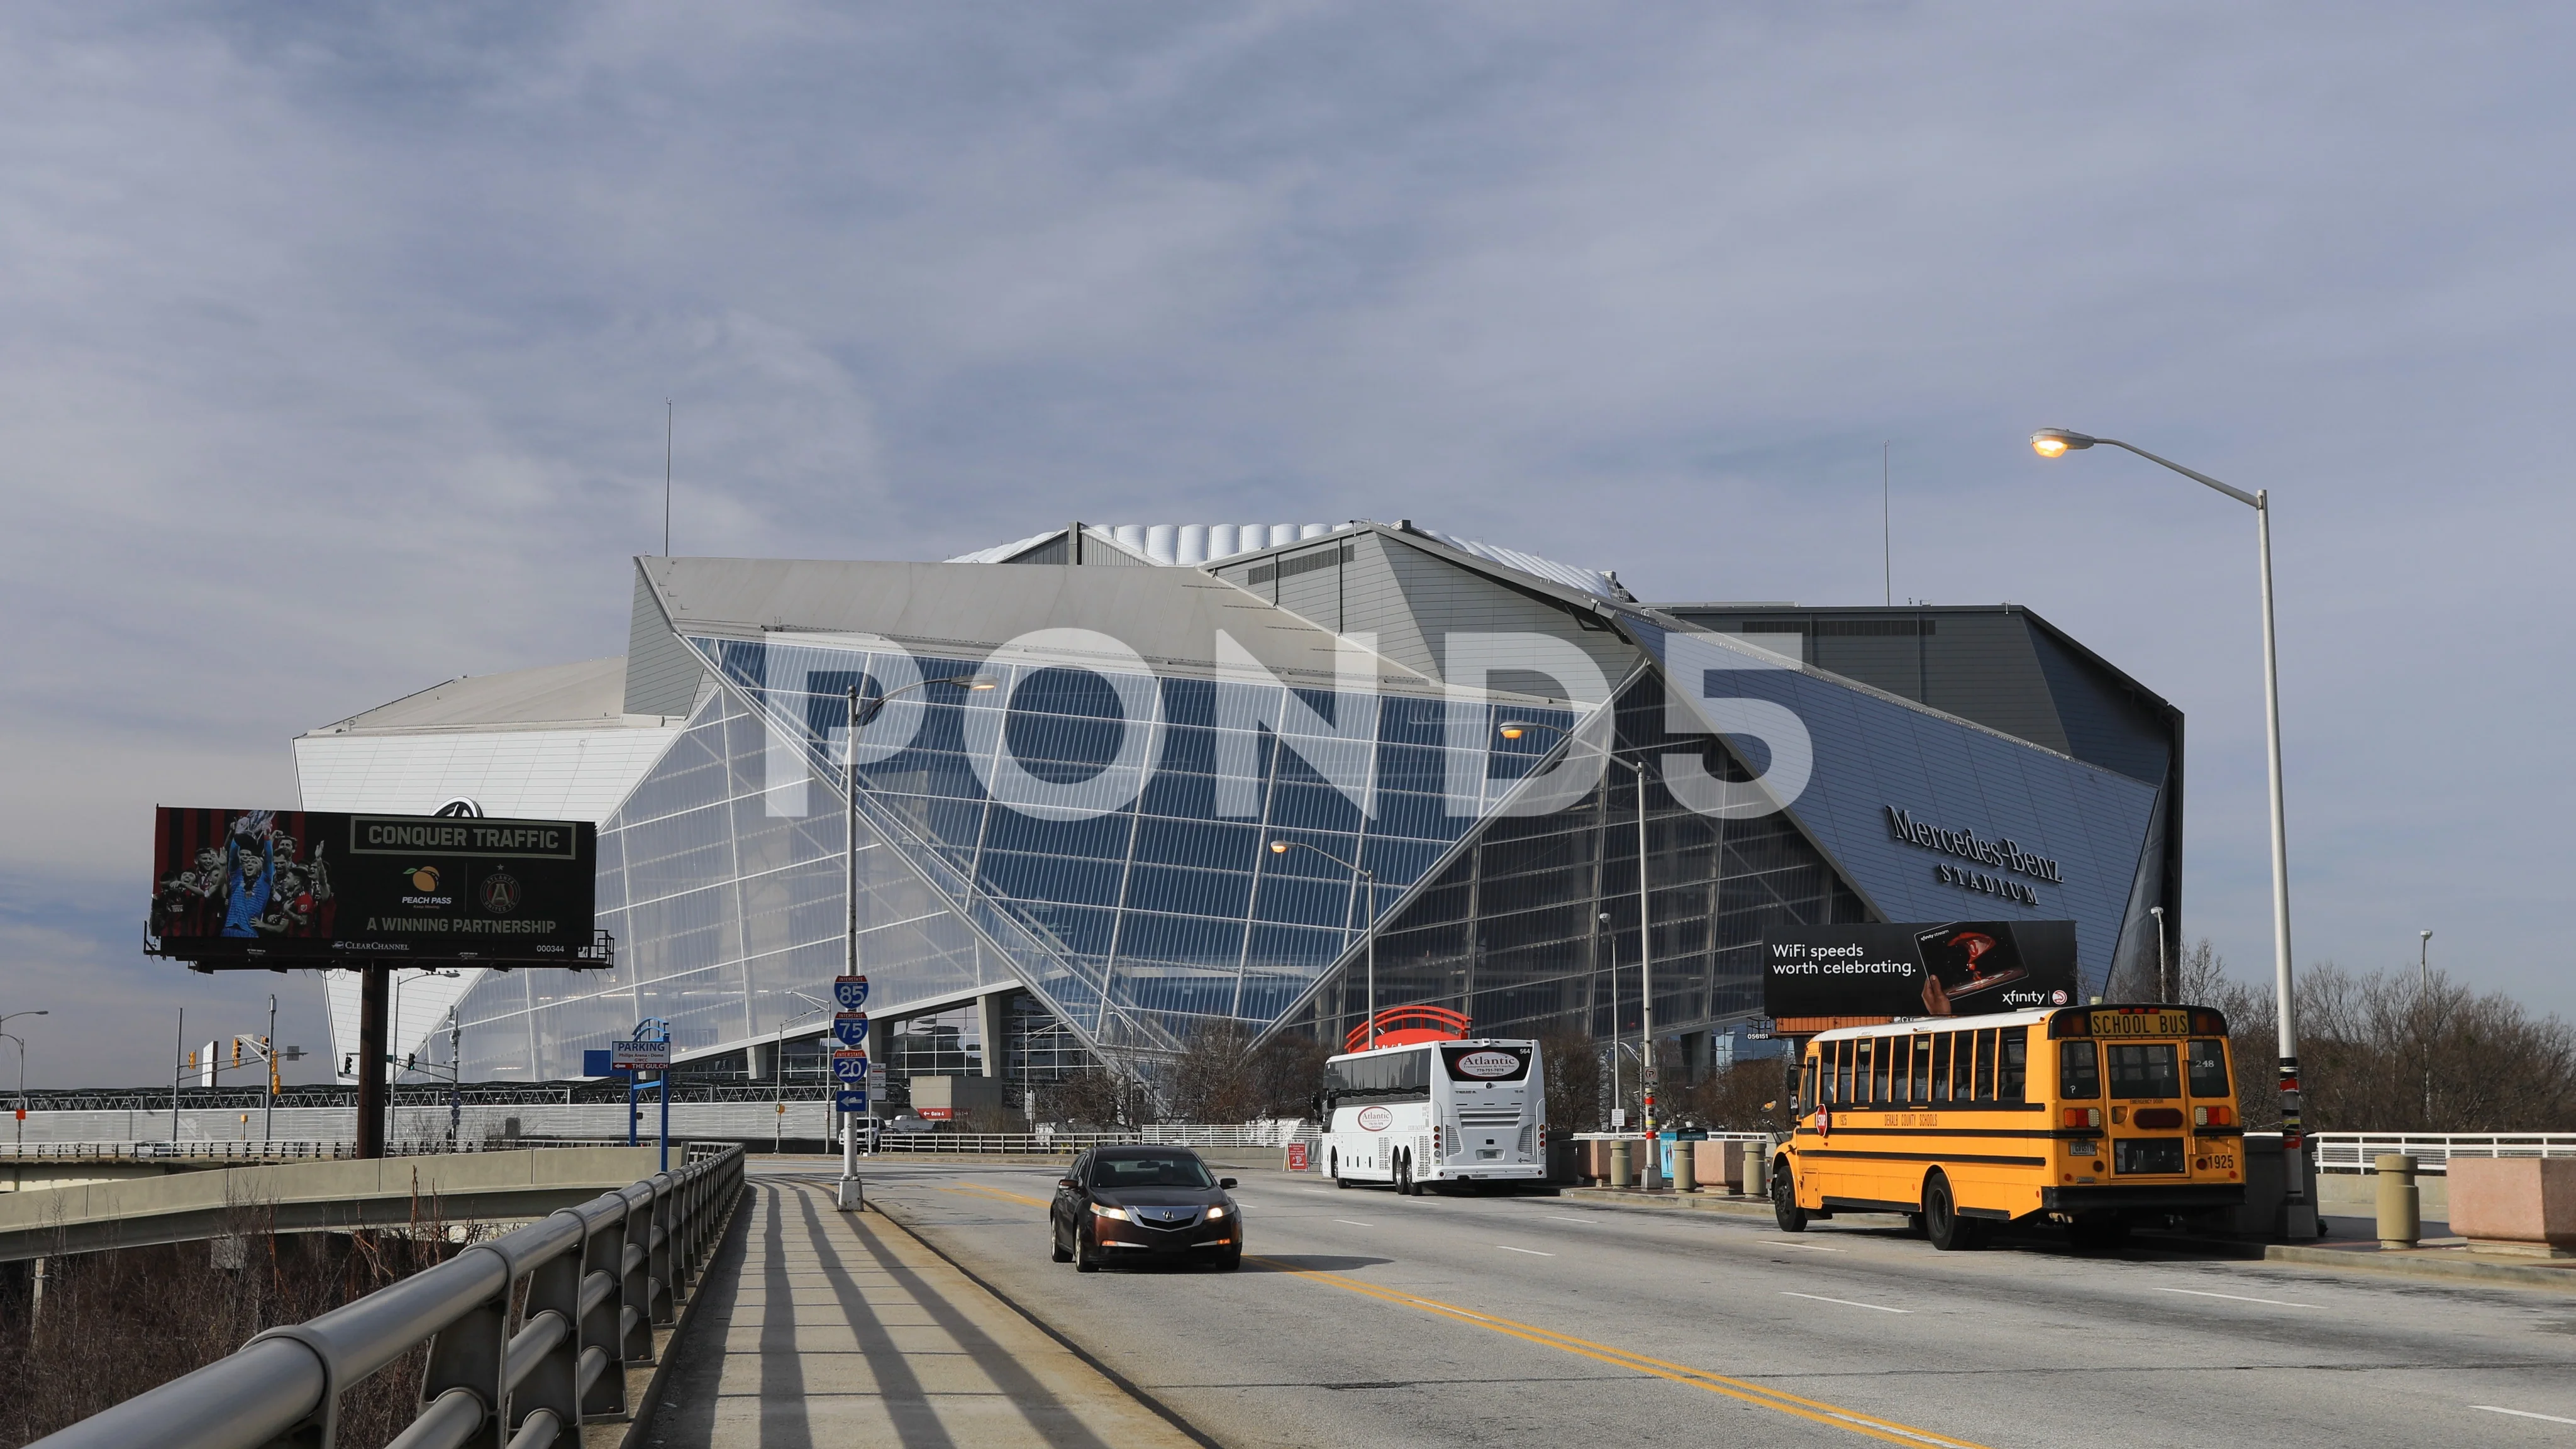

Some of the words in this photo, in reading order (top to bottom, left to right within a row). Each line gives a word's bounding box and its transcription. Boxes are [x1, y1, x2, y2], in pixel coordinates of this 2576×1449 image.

[369, 826, 467, 847] CONQUER
[473, 828, 559, 848] TRAFFIC
[1885, 804, 2064, 884] Mercedes-Benz
[487, 875, 514, 884] ATLANTA
[1938, 863, 2040, 906] STADIUM
[485, 901, 507, 912] UNITED
[367, 918, 377, 931] A
[382, 918, 449, 931] WINNING
[453, 919, 556, 933] PARTNERSHIP
[1772, 944, 1806, 957] WiFi
[1811, 943, 1863, 961] speeds
[1773, 961, 1818, 974] worth
[1823, 960, 1916, 977] celebrating.
[840, 985, 864, 1004] 85
[2002, 990, 2045, 1005] xfinity
[840, 1023, 862, 1038] 75
[2093, 1015, 2150, 1033] SCHOOL
[2160, 1015, 2187, 1033] BUS
[618, 1043, 665, 1051] PARKING
[1464, 1057, 1515, 1065] Atlantic
[2196, 1060, 2214, 1068] 248
[839, 1061, 862, 1077] 20
[1818, 1114, 1826, 1126] STOP
[1839, 1114, 1847, 1126] 1925
[1884, 1114, 1898, 1126] DEKALB
[1901, 1114, 1916, 1126] COUNTY
[1919, 1114, 1938, 1126] SCHOOLS
[2207, 1155, 2233, 1169] 1925
